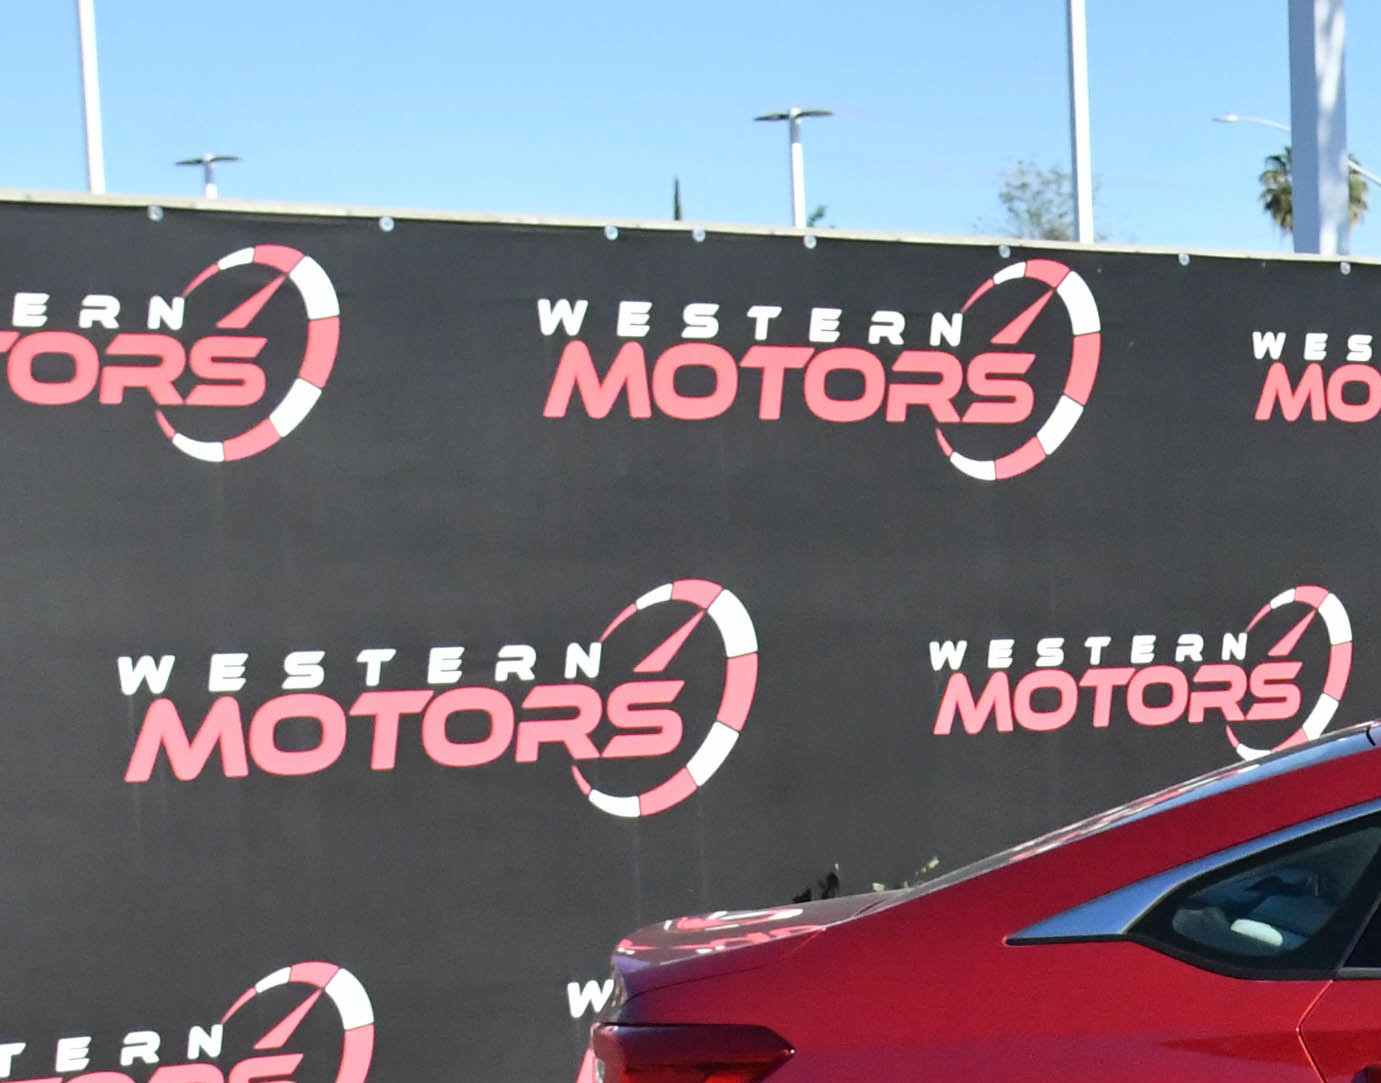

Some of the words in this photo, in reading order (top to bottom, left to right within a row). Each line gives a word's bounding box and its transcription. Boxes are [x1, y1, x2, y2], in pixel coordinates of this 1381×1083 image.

[12, 292, 185, 330] ERN
[538, 299, 963, 346] WESTERN
[543, 340, 1036, 424] MOTORS
[117, 642, 602, 695] WESTERN
[929, 632, 1248, 671] WESTERN
[933, 662, 1302, 735] MOTORS
[124, 680, 686, 783] MOTORS
